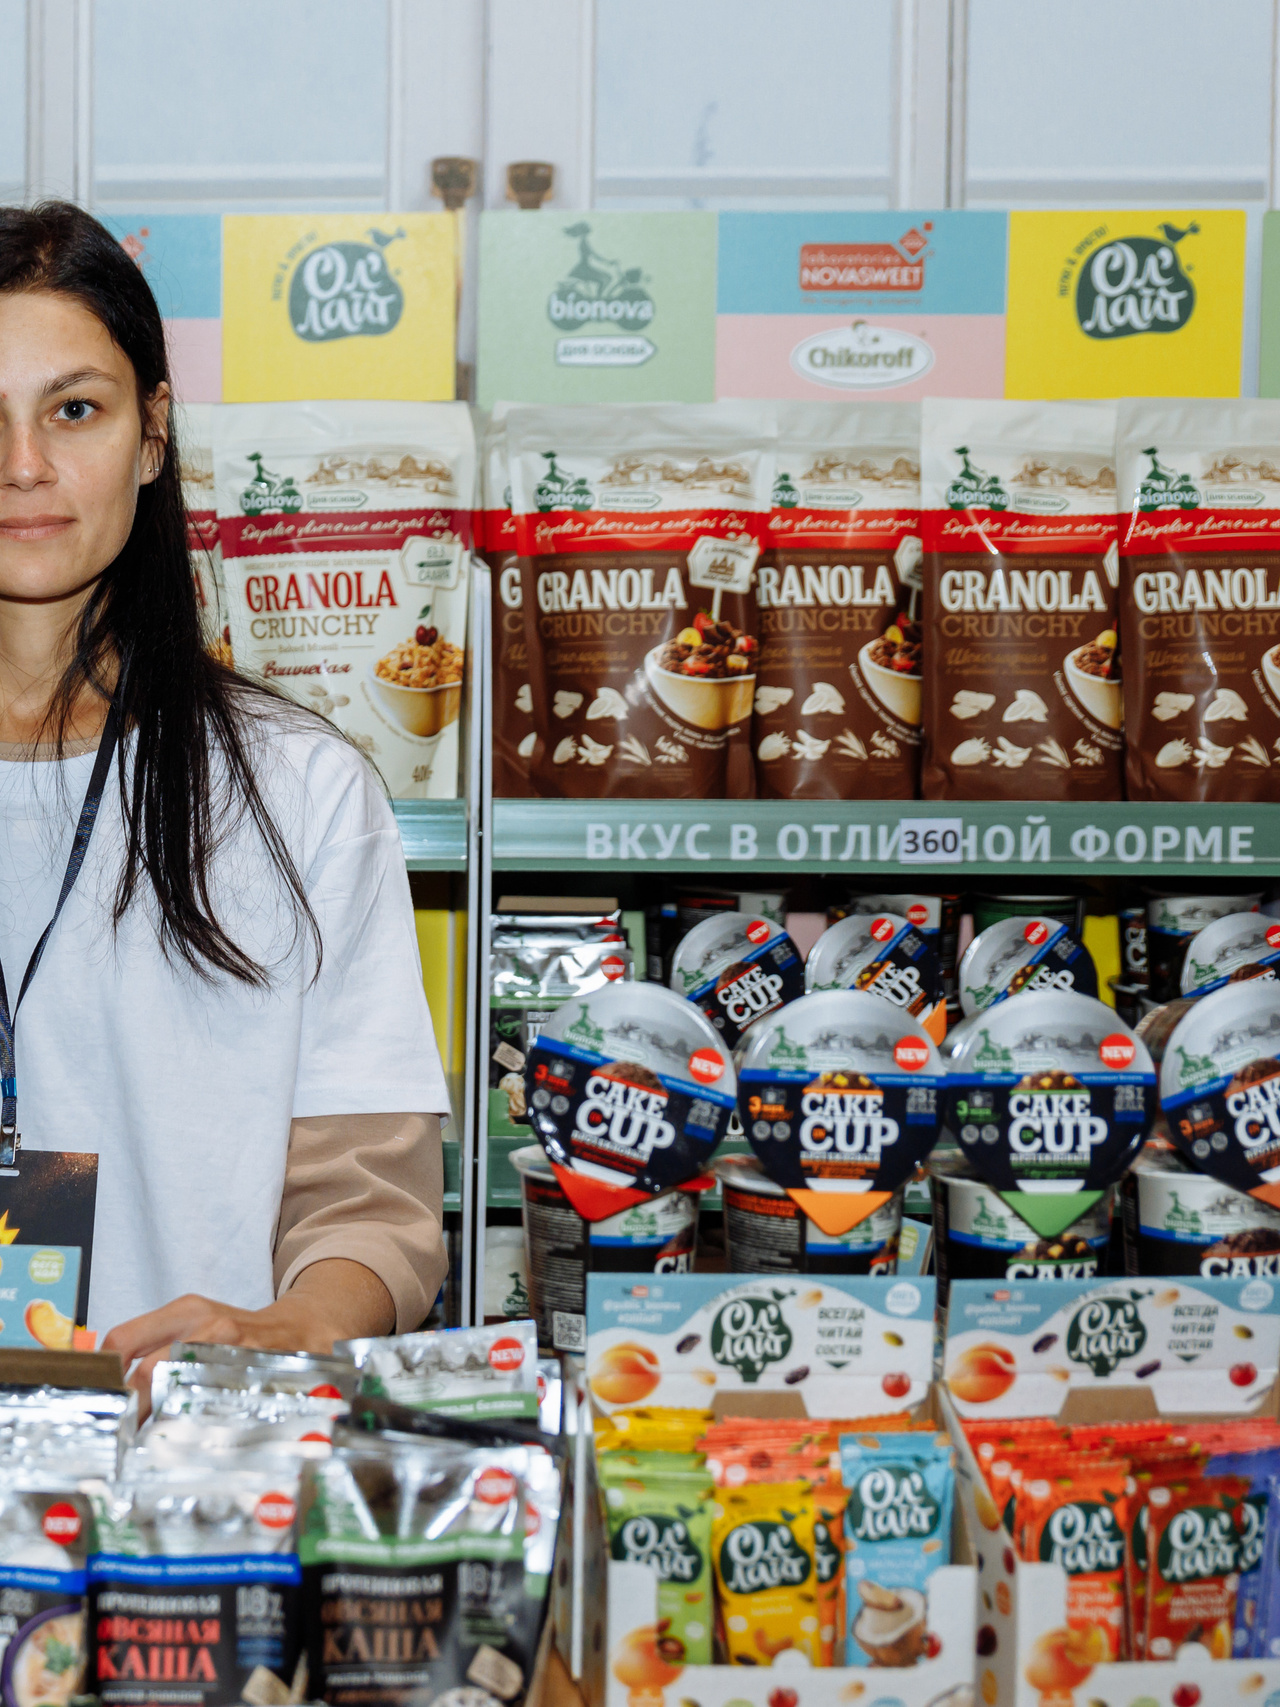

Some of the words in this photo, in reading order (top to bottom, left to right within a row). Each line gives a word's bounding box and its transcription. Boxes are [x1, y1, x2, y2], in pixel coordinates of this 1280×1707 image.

[801, 266, 922, 287] NOVASWEET
[550, 293, 654, 322] bionova
[809, 347, 914, 368] Chikoroff
[241, 494, 303, 510] bionova
[245, 570, 399, 614] GRANOLA
[536, 567, 689, 614] GRANOLA
[758, 564, 895, 609] RANOLA
[939, 569, 1108, 612] GRANOLA
[1133, 566, 1280, 615] GRANOL
[250, 614, 380, 640] CRUNCHY
[539, 611, 666, 638] CRUNCHY
[760, 609, 879, 632] RUNCHY
[940, 614, 1087, 639] CRUNCHY
[1137, 612, 1278, 640] CRUNCHY
[585, 822, 712, 861] ВКУС
[729, 824, 759, 860] В
[776, 815, 1052, 863] ОТЛИНОЙ
[1069, 824, 1255, 864] ФОРМЕ
[903, 829, 959, 854] 360
[717, 966, 768, 1005] CAKE
[727, 974, 784, 1022] CUP
[692, 1057, 725, 1076] NEW
[896, 1047, 930, 1061] NEW
[1100, 1046, 1134, 1060] NEW
[585, 1075, 669, 1119] CAKE
[801, 1093, 883, 1118] CAKE
[1008, 1093, 1091, 1118] CAKE
[576, 1099, 676, 1151] CUP
[799, 1117, 900, 1153] CUP
[1008, 1116, 1108, 1152] CUP
[491, 1350, 524, 1364] NEW
[43, 1519, 81, 1533] NEW
[322, 1626, 441, 1663] КАША
[97, 1646, 218, 1682] КАША
